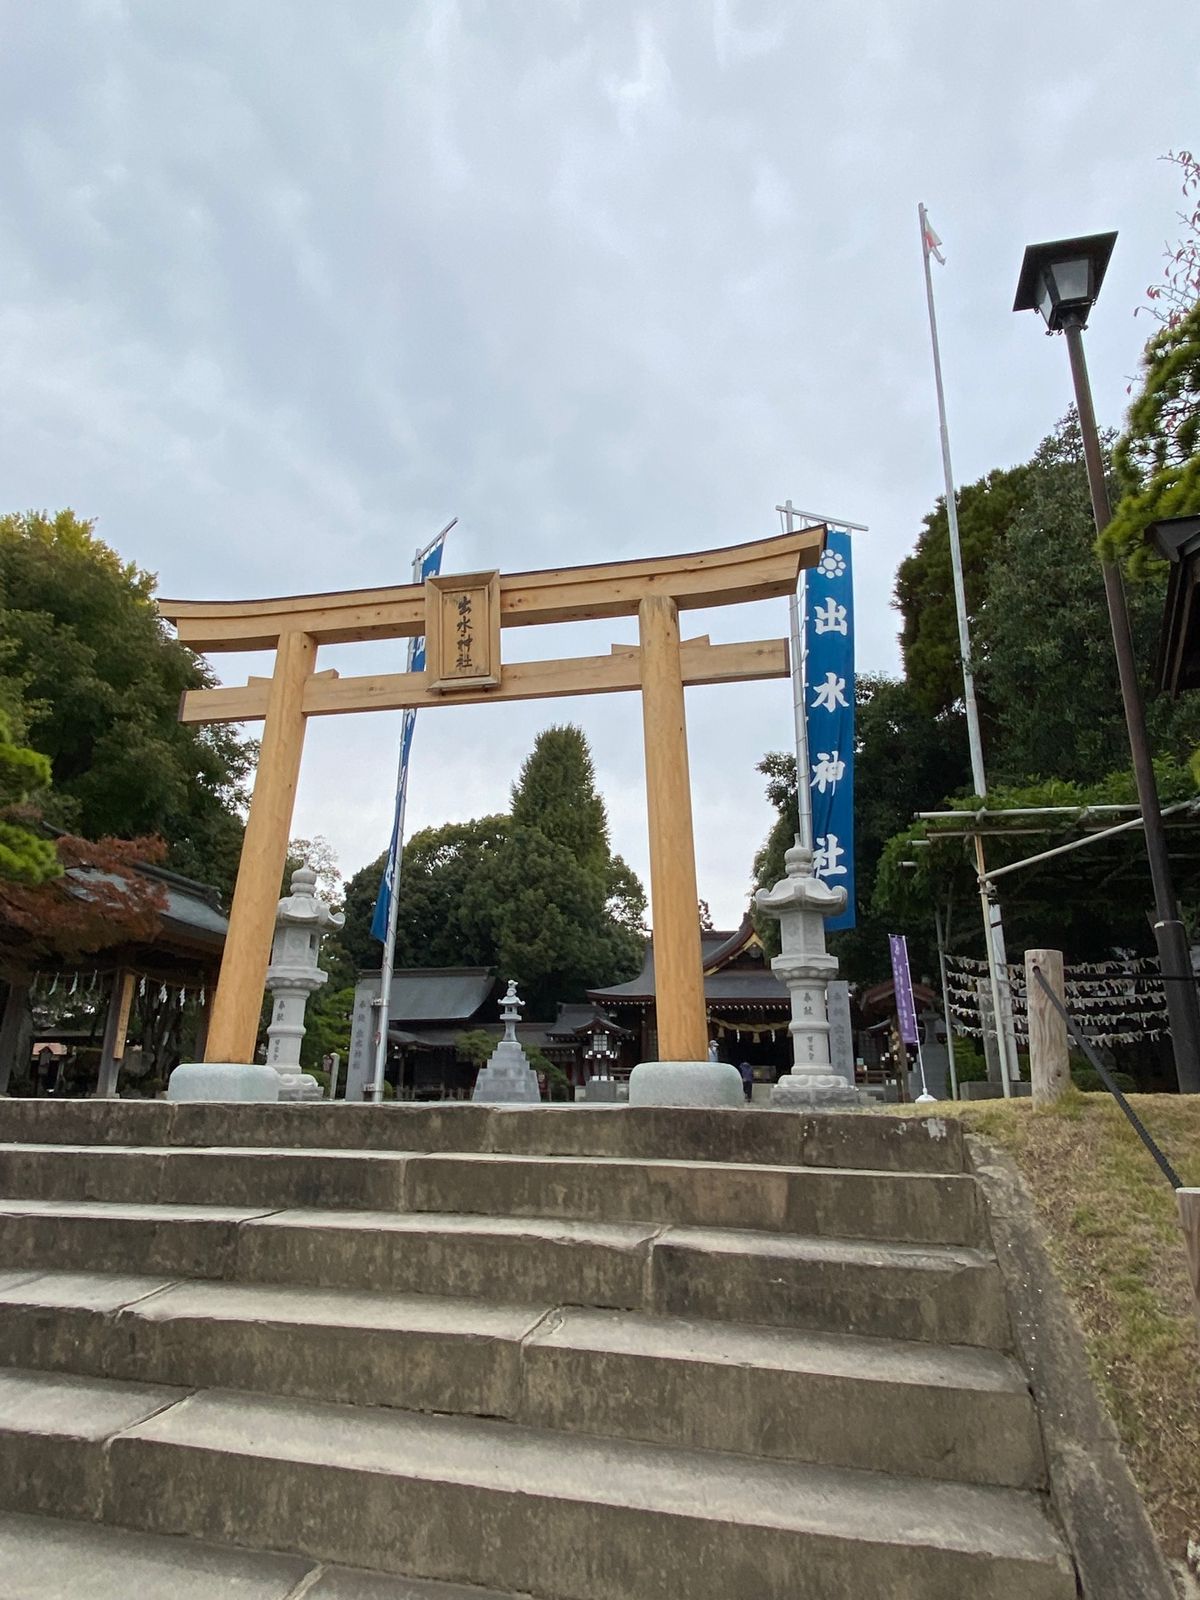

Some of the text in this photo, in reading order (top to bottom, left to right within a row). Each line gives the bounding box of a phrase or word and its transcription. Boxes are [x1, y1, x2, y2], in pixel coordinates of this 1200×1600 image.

[456, 596, 473, 671] 出水神社
[810, 597, 850, 878] 出水神社
